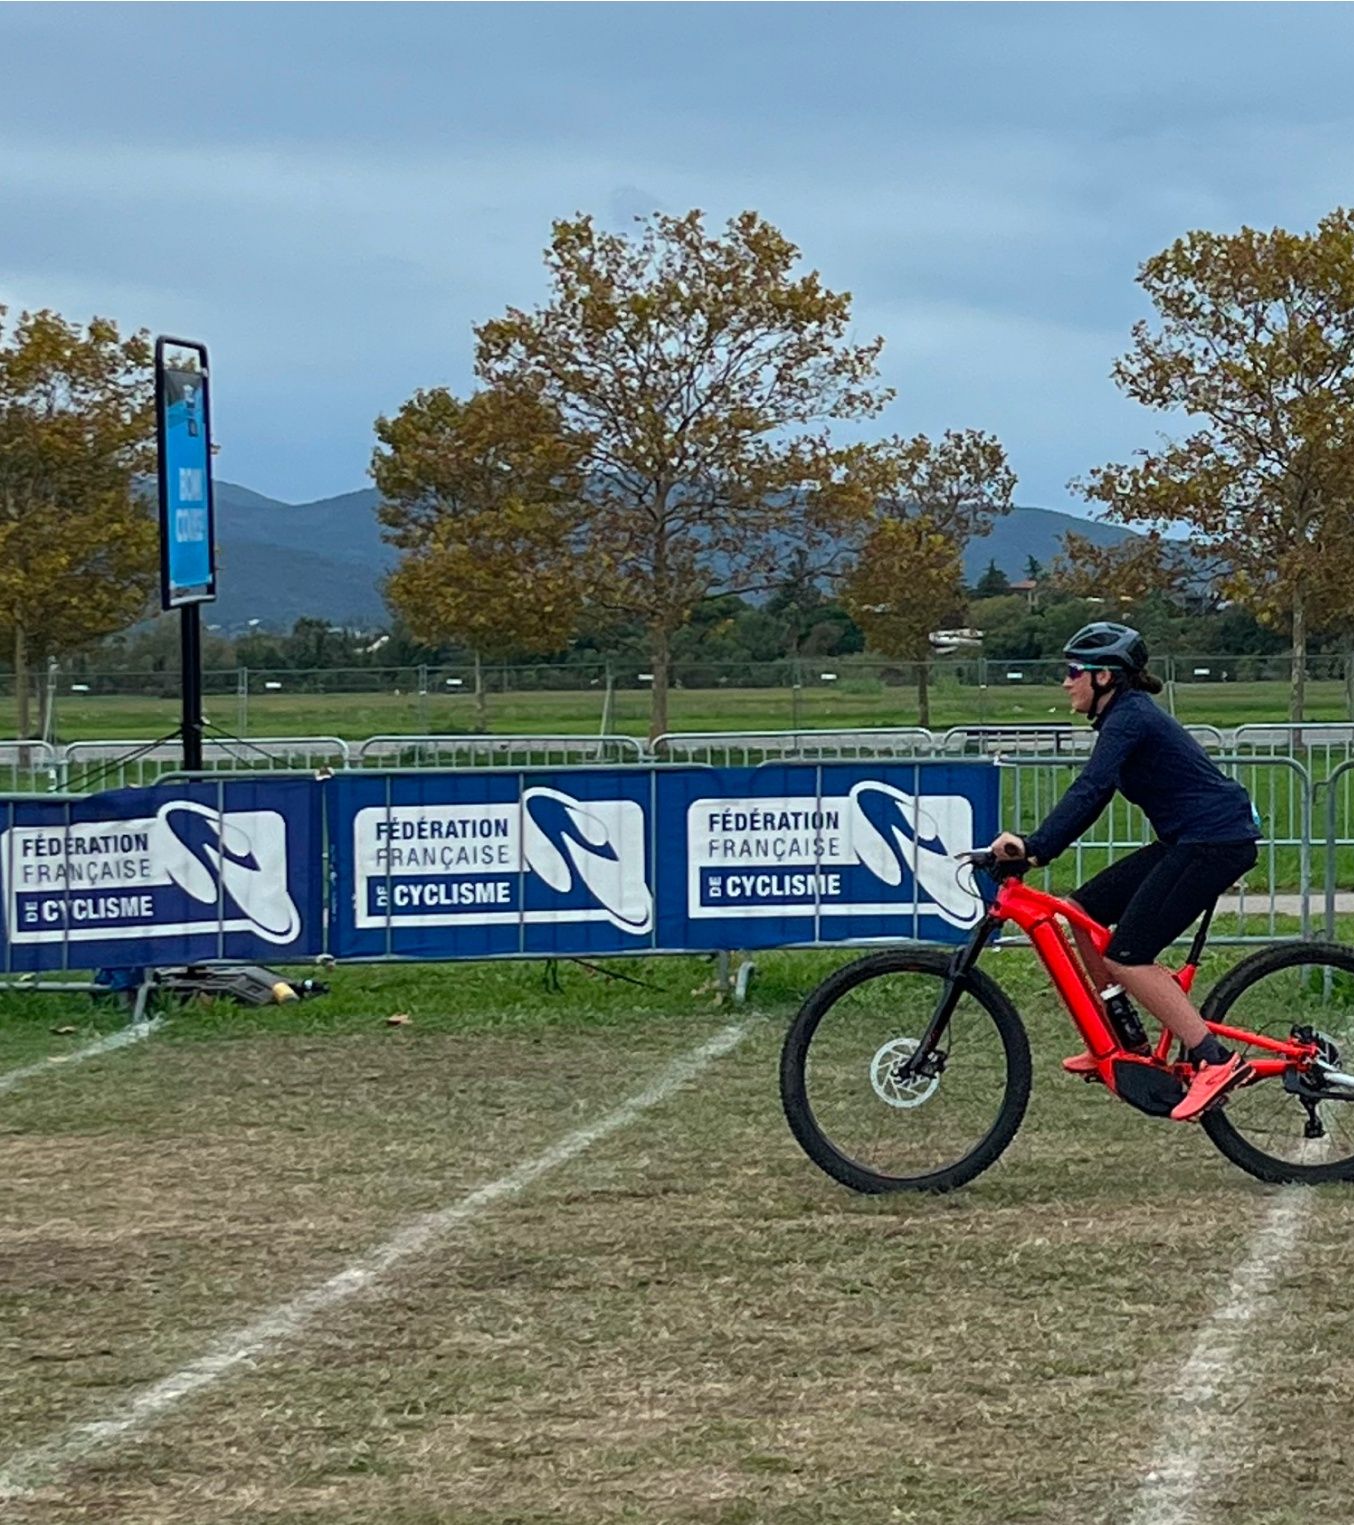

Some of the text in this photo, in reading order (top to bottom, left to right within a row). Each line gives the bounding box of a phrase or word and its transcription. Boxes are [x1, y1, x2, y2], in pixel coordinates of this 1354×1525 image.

[376, 817, 509, 841] FÉDÉRATION
[708, 808, 840, 832] FÉDÉRATION
[376, 845, 510, 870] FRANÇAISE
[708, 838, 841, 861] FRANÇAISE
[23, 859, 151, 885] FRANÇAISE
[393, 882, 511, 906] CYCLISME
[708, 874, 841, 897] DE CYCLISME
[24, 902, 38, 922] DE
